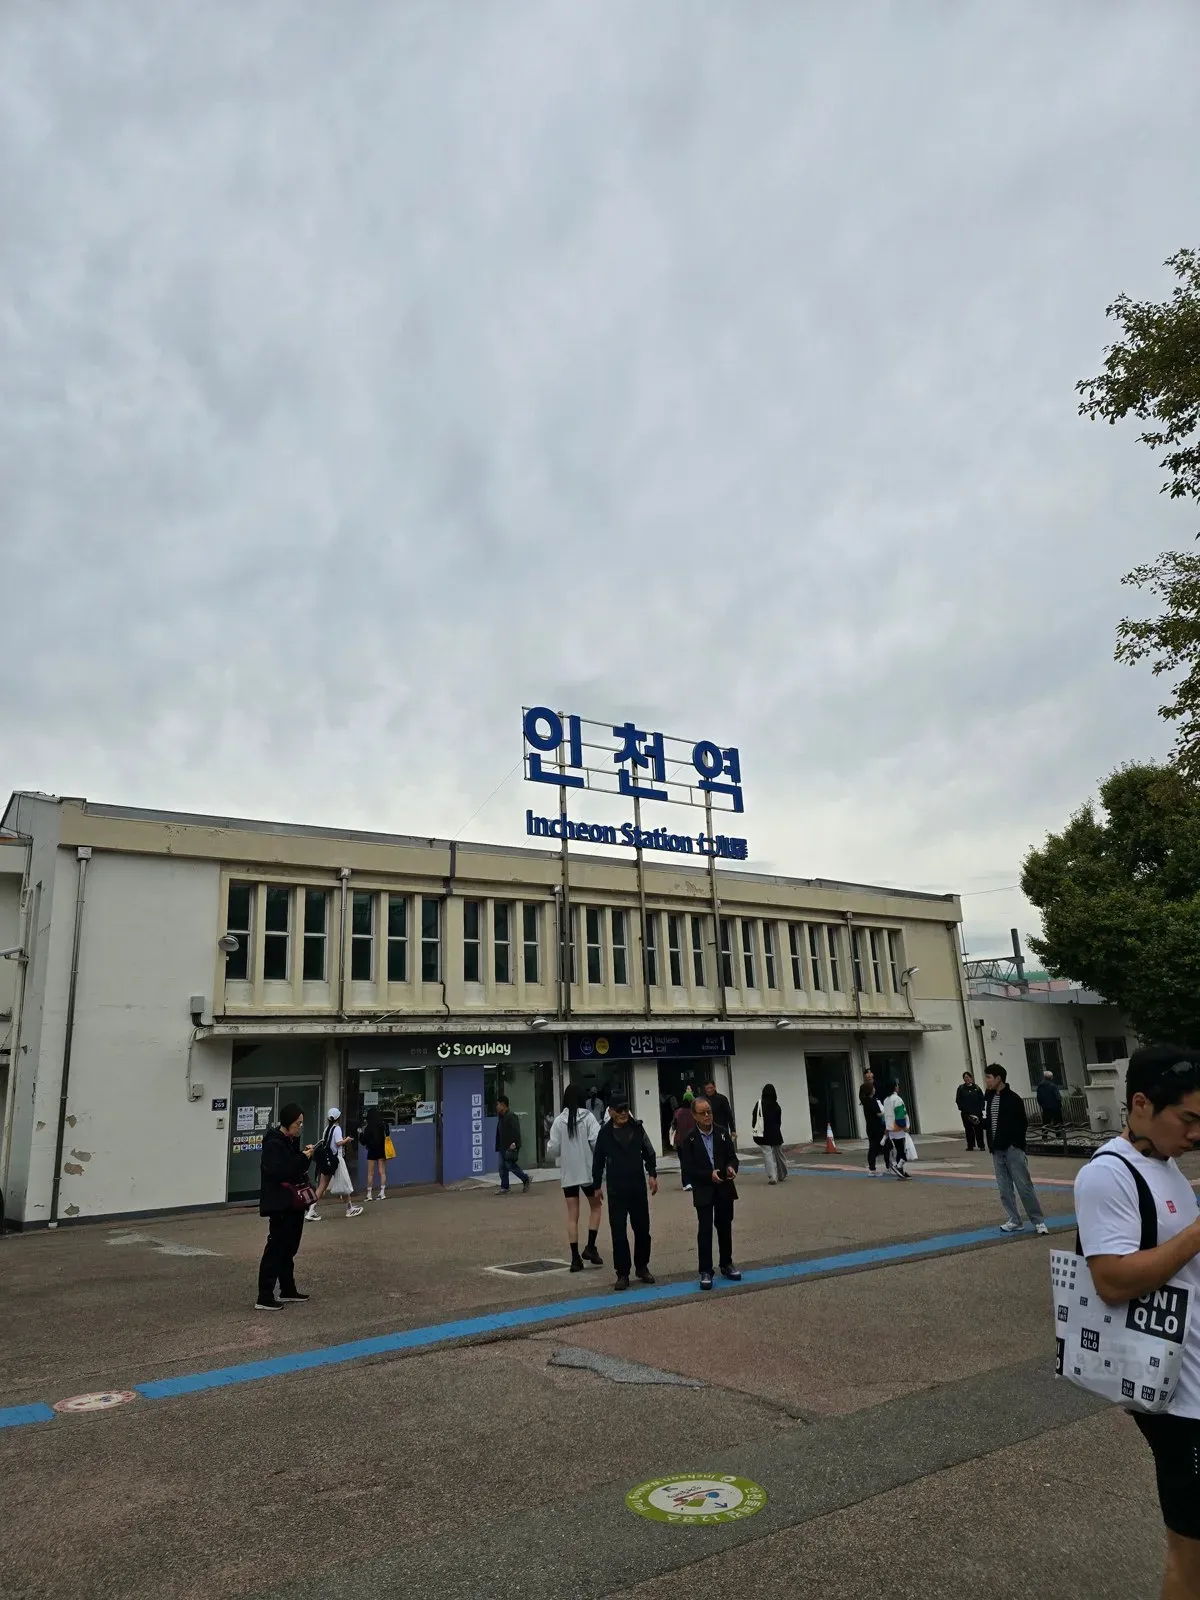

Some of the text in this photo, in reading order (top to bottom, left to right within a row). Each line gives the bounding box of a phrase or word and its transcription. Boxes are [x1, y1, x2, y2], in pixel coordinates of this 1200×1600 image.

[523, 706, 744, 813] 인천역
[526, 809, 617, 844] Incheon
[620, 822, 693, 854] Station
[630, 1036, 654, 1054] 인천
[654, 1036, 680, 1044] Incheon
[719, 1036, 726, 1051] 1
[1134, 1306, 1179, 1334] QLO
[1083, 1330, 1097, 1341] UNI
[1082, 1339, 1098, 1349] QLO
[1122, 1387, 1132, 1396] QLO
[1123, 1381, 1133, 1389] UNI
